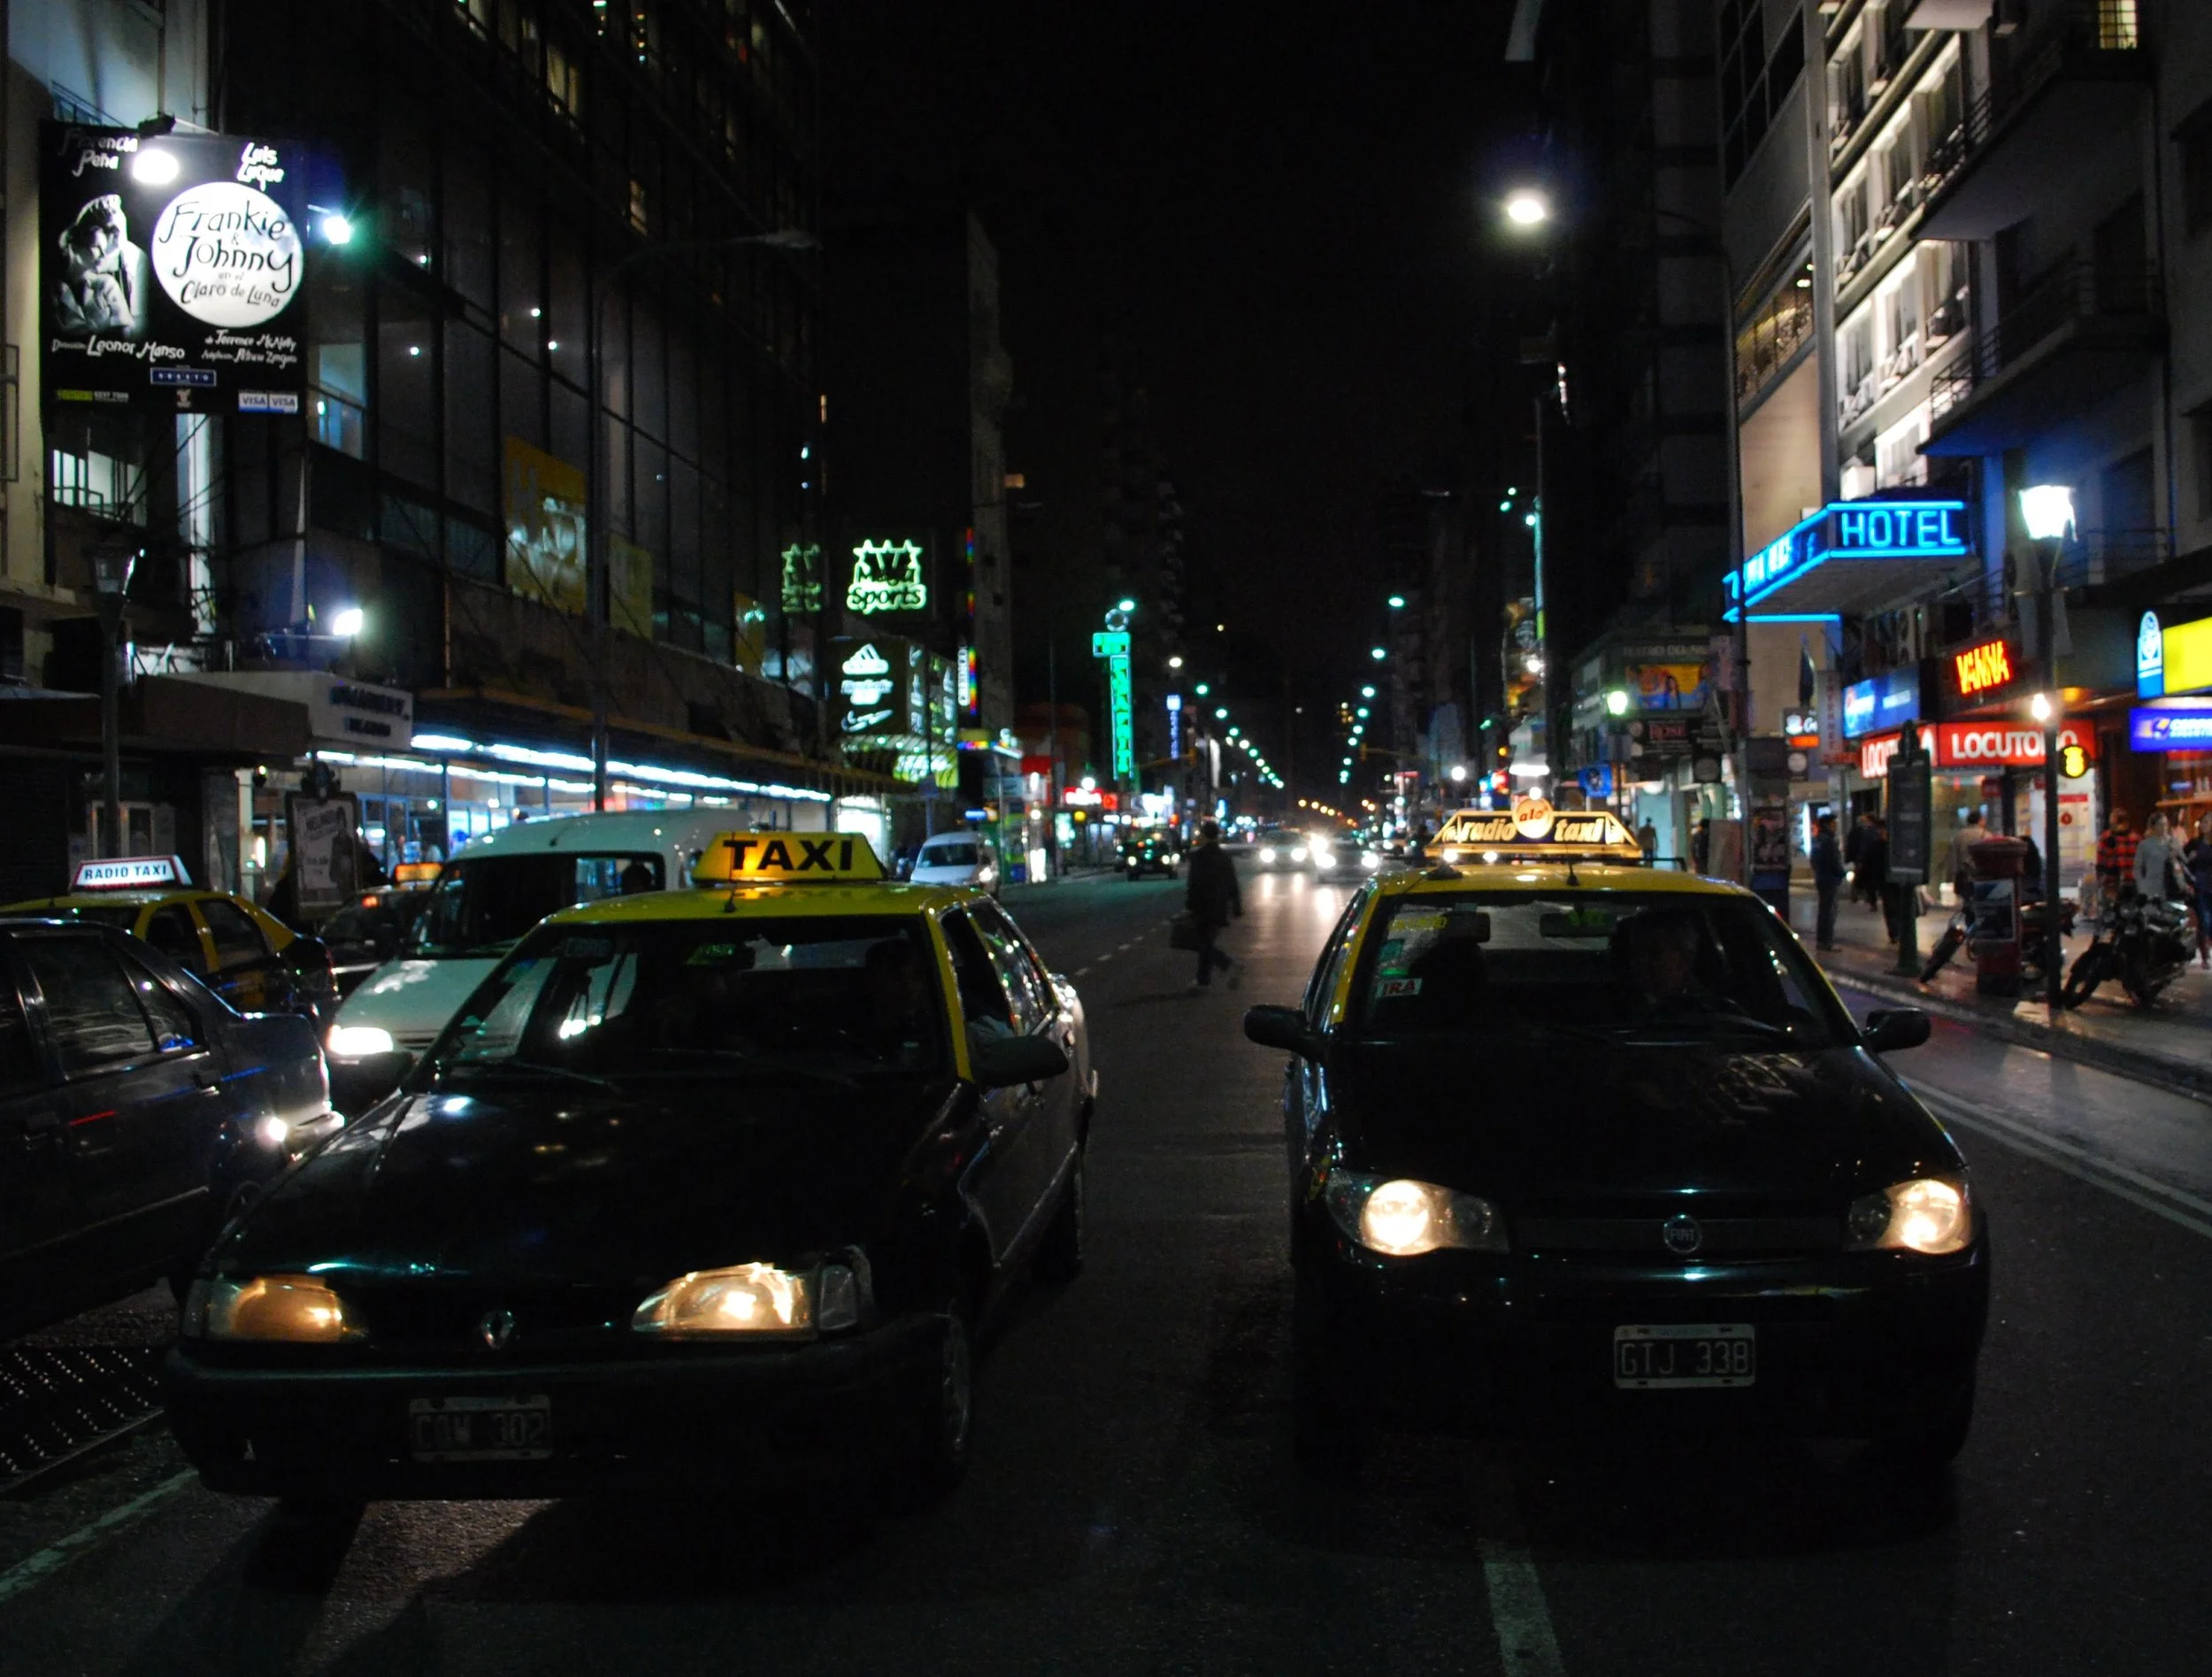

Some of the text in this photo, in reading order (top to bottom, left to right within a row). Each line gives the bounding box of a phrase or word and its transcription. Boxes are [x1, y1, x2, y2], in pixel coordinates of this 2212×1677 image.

[242, 142, 278, 165] Luis
[236, 163, 285, 192] Luque
[158, 200, 286, 244] Frankie
[173, 235, 293, 294] Johnny
[180, 280, 280, 308] Claro de Luna
[87, 335, 136, 357] Leonor
[1841, 510, 1962, 547] HOTEL
[849, 586, 923, 613] Sports
[1951, 729, 2078, 759] LOCUTOO
[1461, 817, 1518, 842] radio
[1554, 818, 1604, 842] taxi
[722, 838, 854, 871] TAXI
[85, 865, 167, 880] RADIO TAXI
[1620, 1340, 1750, 1376] GTJ 338
